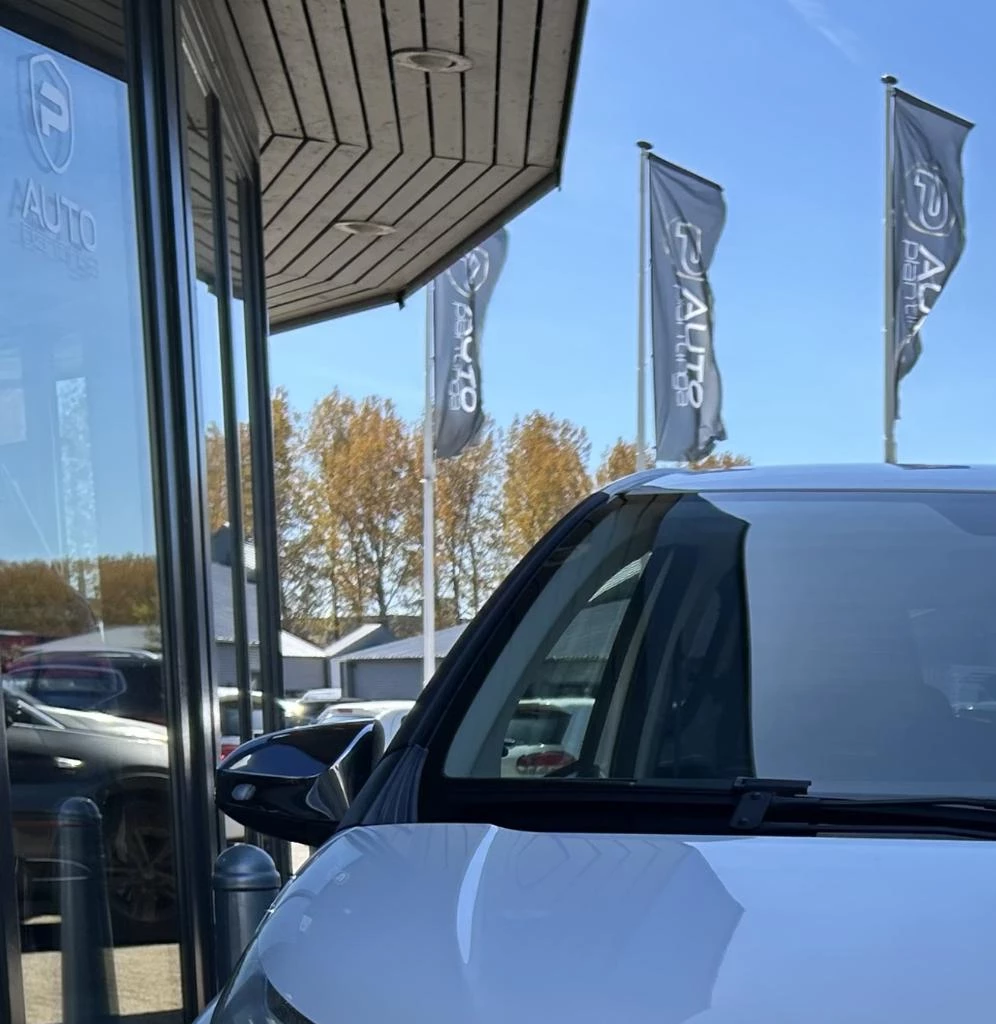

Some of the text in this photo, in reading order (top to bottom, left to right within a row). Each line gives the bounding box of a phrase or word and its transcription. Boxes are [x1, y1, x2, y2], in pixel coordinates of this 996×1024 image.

[22, 177, 97, 252] AUTO
[915, 244, 946, 320] AU
[681, 288, 708, 409] AUTO
